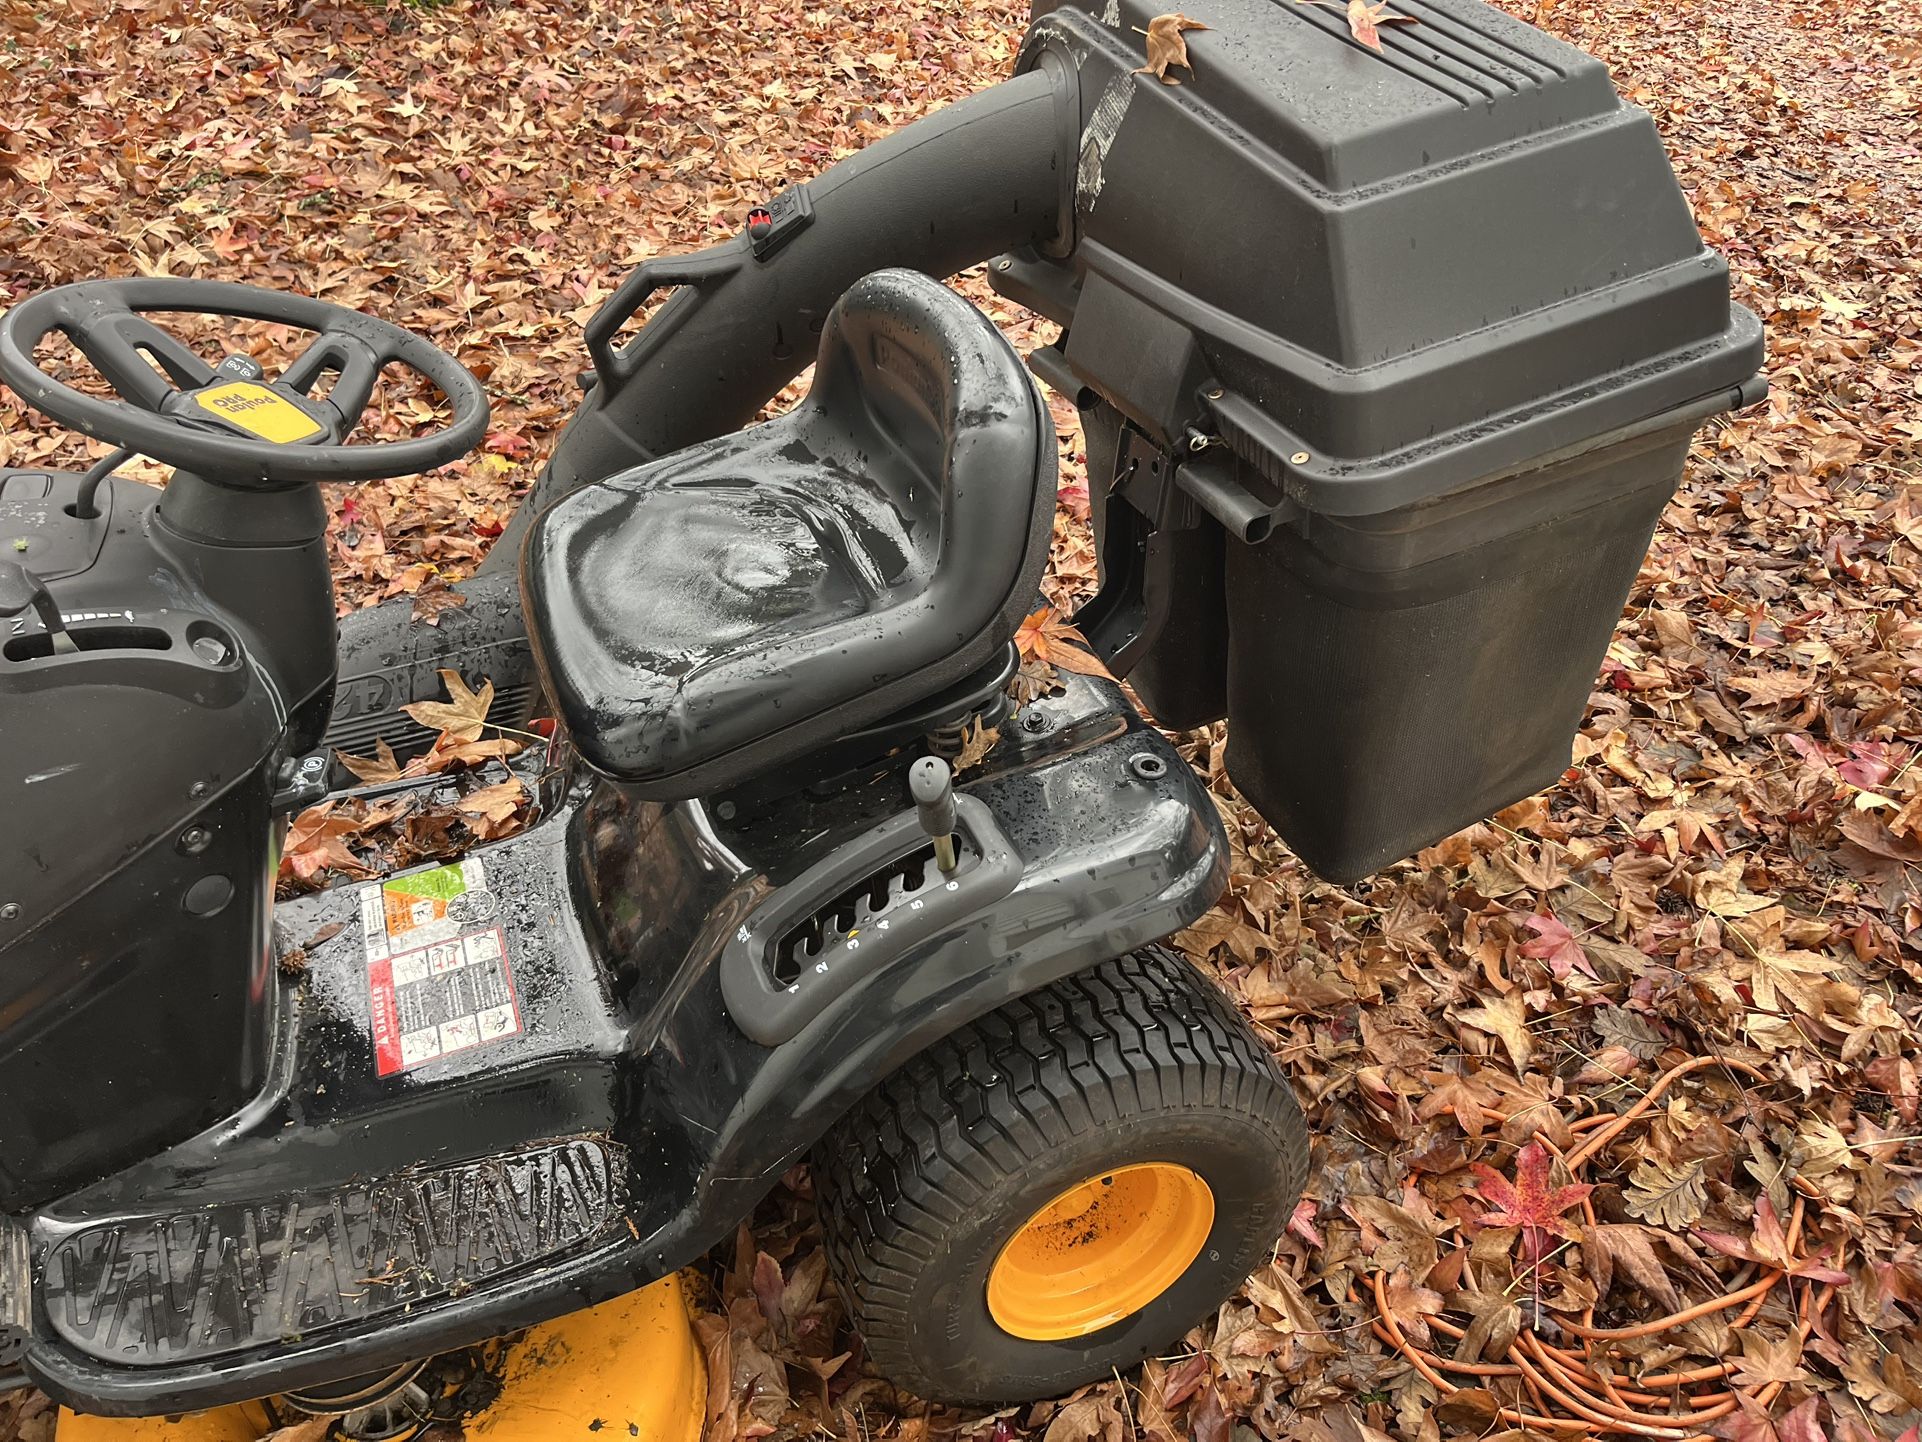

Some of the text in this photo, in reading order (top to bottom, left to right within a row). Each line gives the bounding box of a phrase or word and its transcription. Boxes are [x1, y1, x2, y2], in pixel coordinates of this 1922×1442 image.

[213, 393, 247, 407] PRO
[225, 395, 277, 413] Poulan
[945, 881, 959, 891] 6
[910, 899, 924, 910] 5
[875, 919, 890, 930] 4
[846, 938, 860, 950] 3
[815, 961, 829, 974] 2
[788, 983, 800, 994] 1
[372, 985, 389, 1034] DANGER
